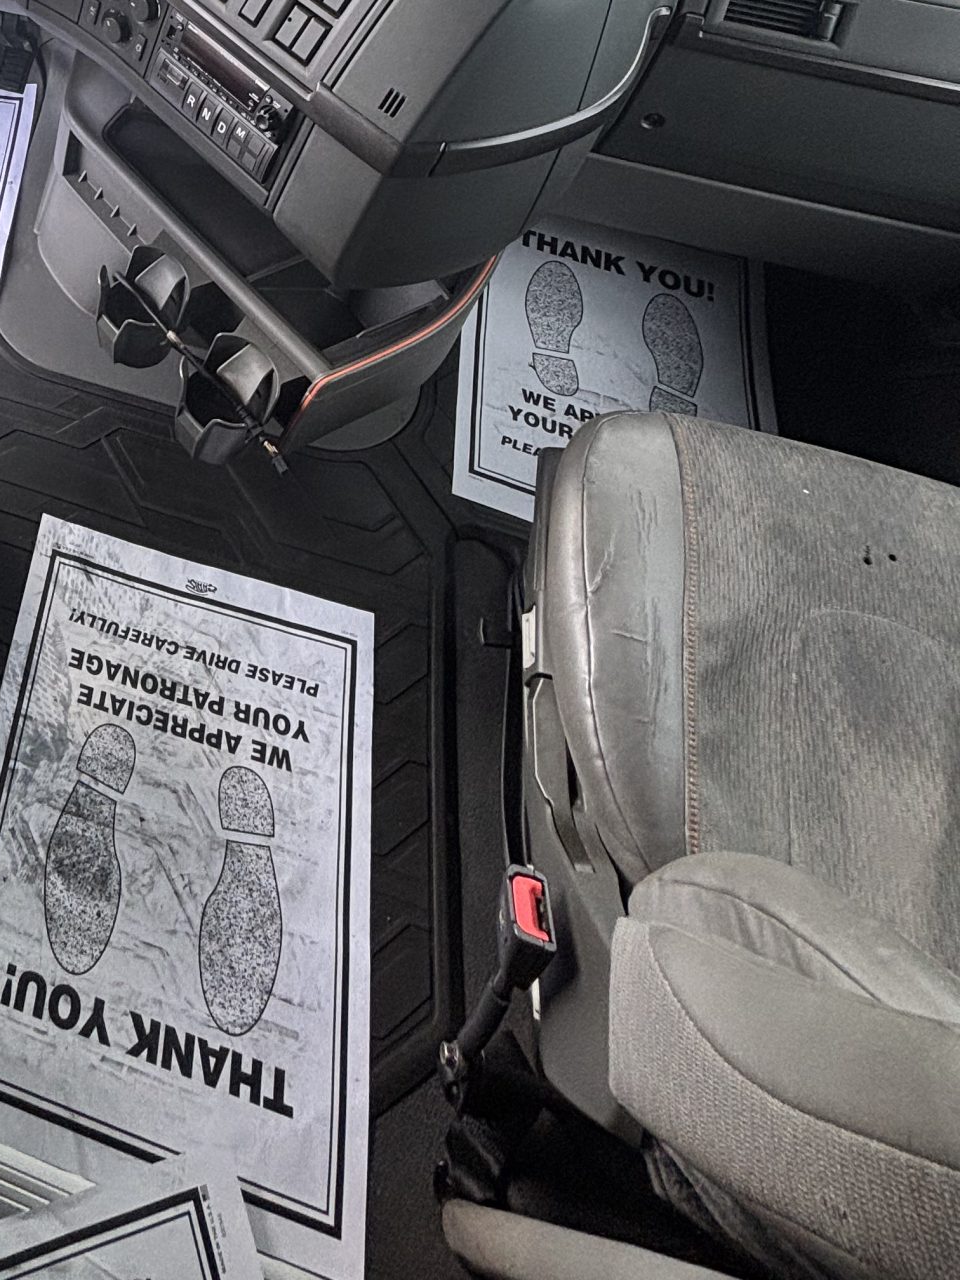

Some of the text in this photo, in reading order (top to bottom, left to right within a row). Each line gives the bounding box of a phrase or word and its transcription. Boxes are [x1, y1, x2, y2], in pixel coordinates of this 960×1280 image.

[186, 94, 246, 139] R N D M
[522, 229, 715, 302] THANK YOU!
[508, 404, 574, 440] YOUR
[521, 388, 557, 412] WE
[501, 435, 541, 456] PLEA
[70, 607, 320, 698] PLEASE DRIVE CAREFULLY!
[68, 647, 310, 743] YOUR PATRONAGE
[76, 683, 293, 772] WE APPRECIATE
[0, 962, 294, 1119] THANK YOU!
